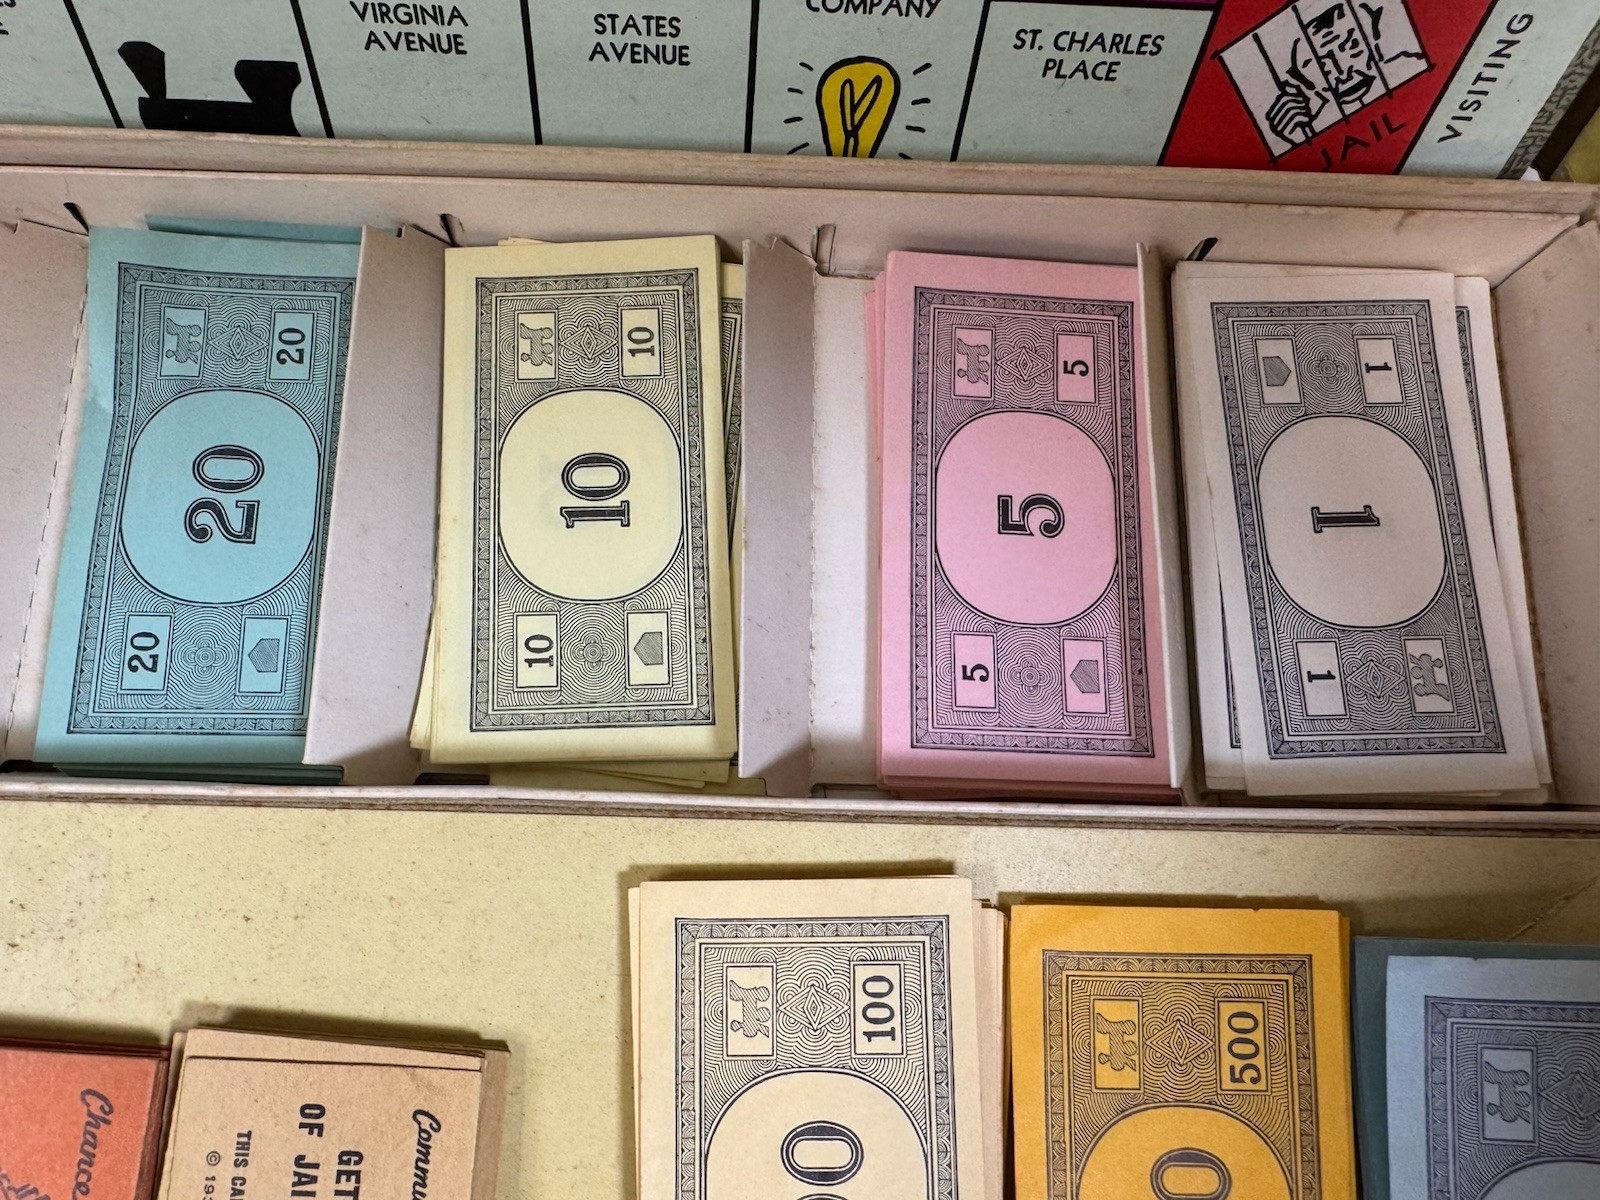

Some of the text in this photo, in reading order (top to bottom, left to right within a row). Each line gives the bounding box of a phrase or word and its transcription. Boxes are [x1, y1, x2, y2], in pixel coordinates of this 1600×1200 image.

[349, 0, 469, 27] VIRGINIA
[593, 13, 681, 38] STATES
[364, 30, 468, 55] AVENUE
[588, 41, 691, 66] AVENUE
[1013, 28, 1165, 56] ST. CHARLES
[1043, 58, 1118, 82] PLACE
[1437, 13, 1534, 143] VISITING
[1320, 113, 1406, 172] JAIL
[275, 327, 305, 366] 20
[627, 326, 656, 358] 10
[1063, 359, 1090, 378] 5
[1364, 361, 1392, 374] 1
[184, 444, 264, 544] 20
[560, 452, 630, 528] 10
[997, 492, 1065, 537] 5
[1310, 505, 1381, 534] 1
[127, 631, 159, 673] 20
[524, 633, 554, 668] 10
[962, 663, 990, 682] 5
[1306, 669, 1336, 681] 1
[861, 972, 897, 1043] 100
[1227, 1010, 1261, 1086] 500
[298, 1103, 326, 1138] OF
[72, 1088, 114, 1200] Chance
[229, 1130, 252, 1200] THIS CA
[334, 1150, 364, 1200] GET
